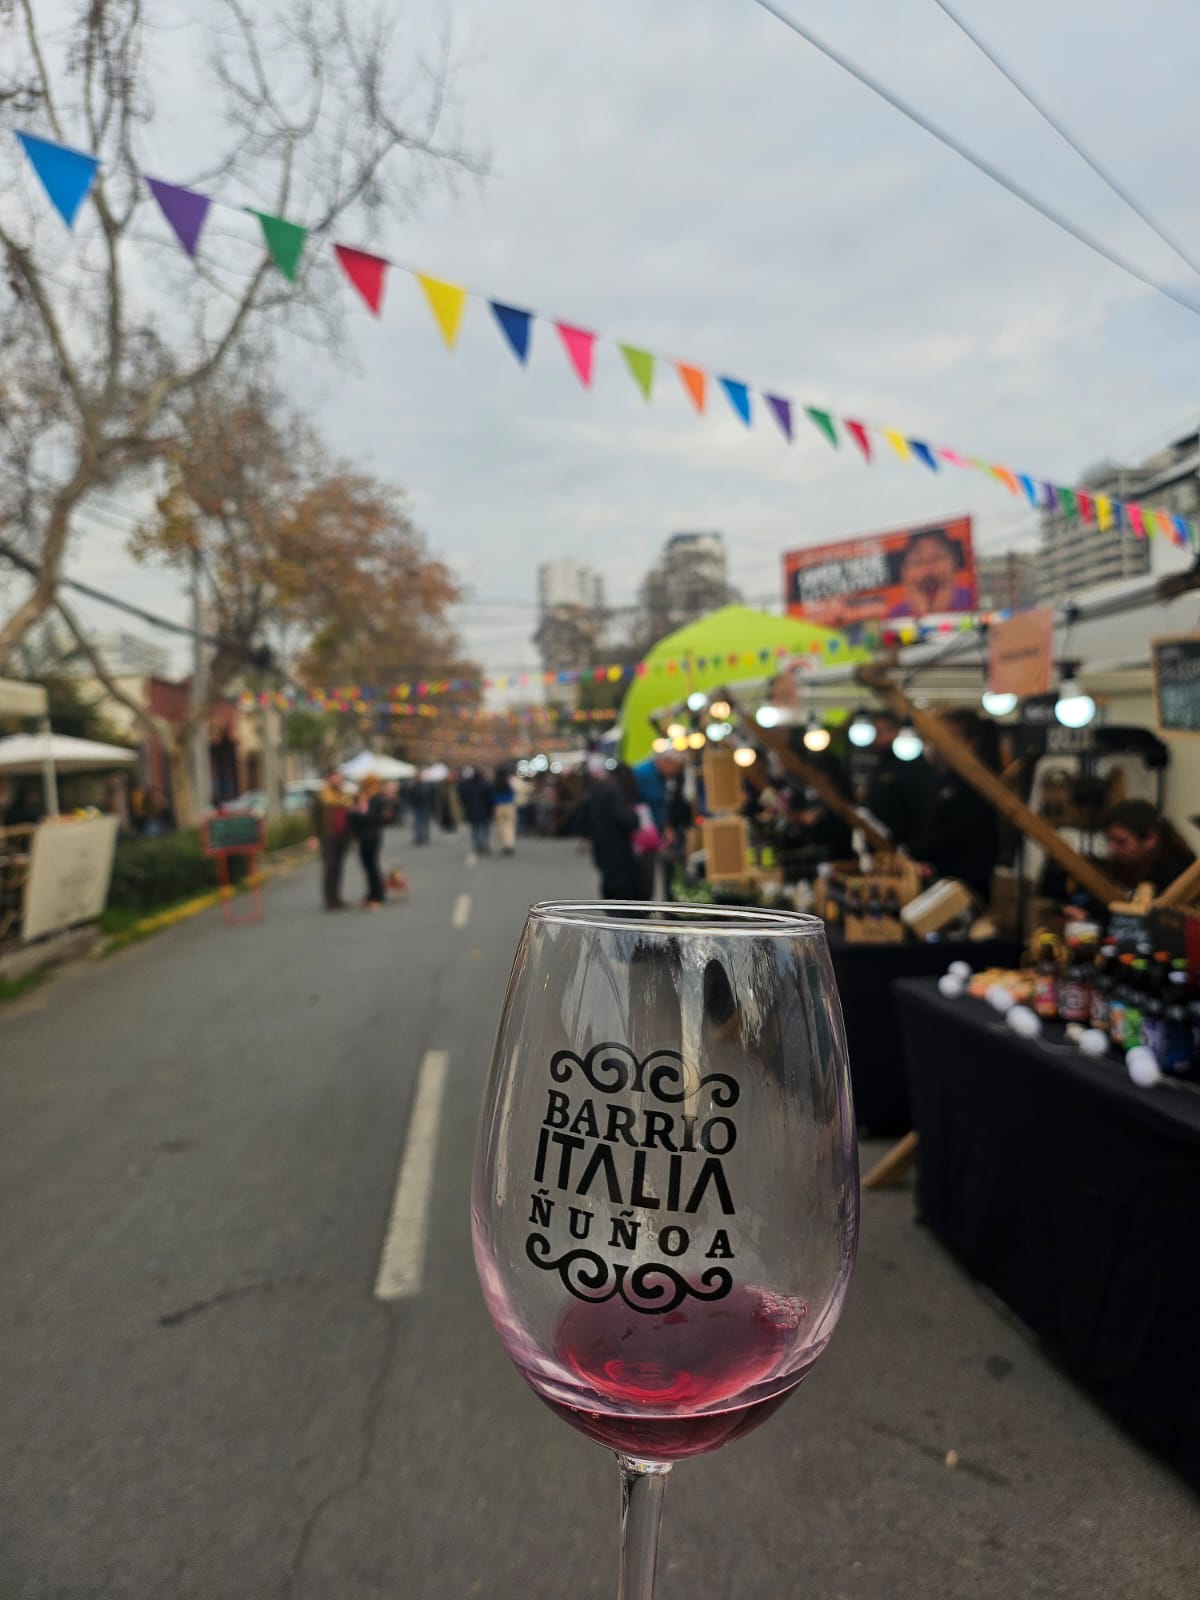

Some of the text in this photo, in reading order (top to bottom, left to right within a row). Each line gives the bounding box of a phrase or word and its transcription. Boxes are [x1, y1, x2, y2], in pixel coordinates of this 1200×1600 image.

[543, 1089, 737, 1155] BARRIO
[534, 1128, 735, 1215] ITALIA
[528, 1188, 734, 1258] ÑUÑOA
